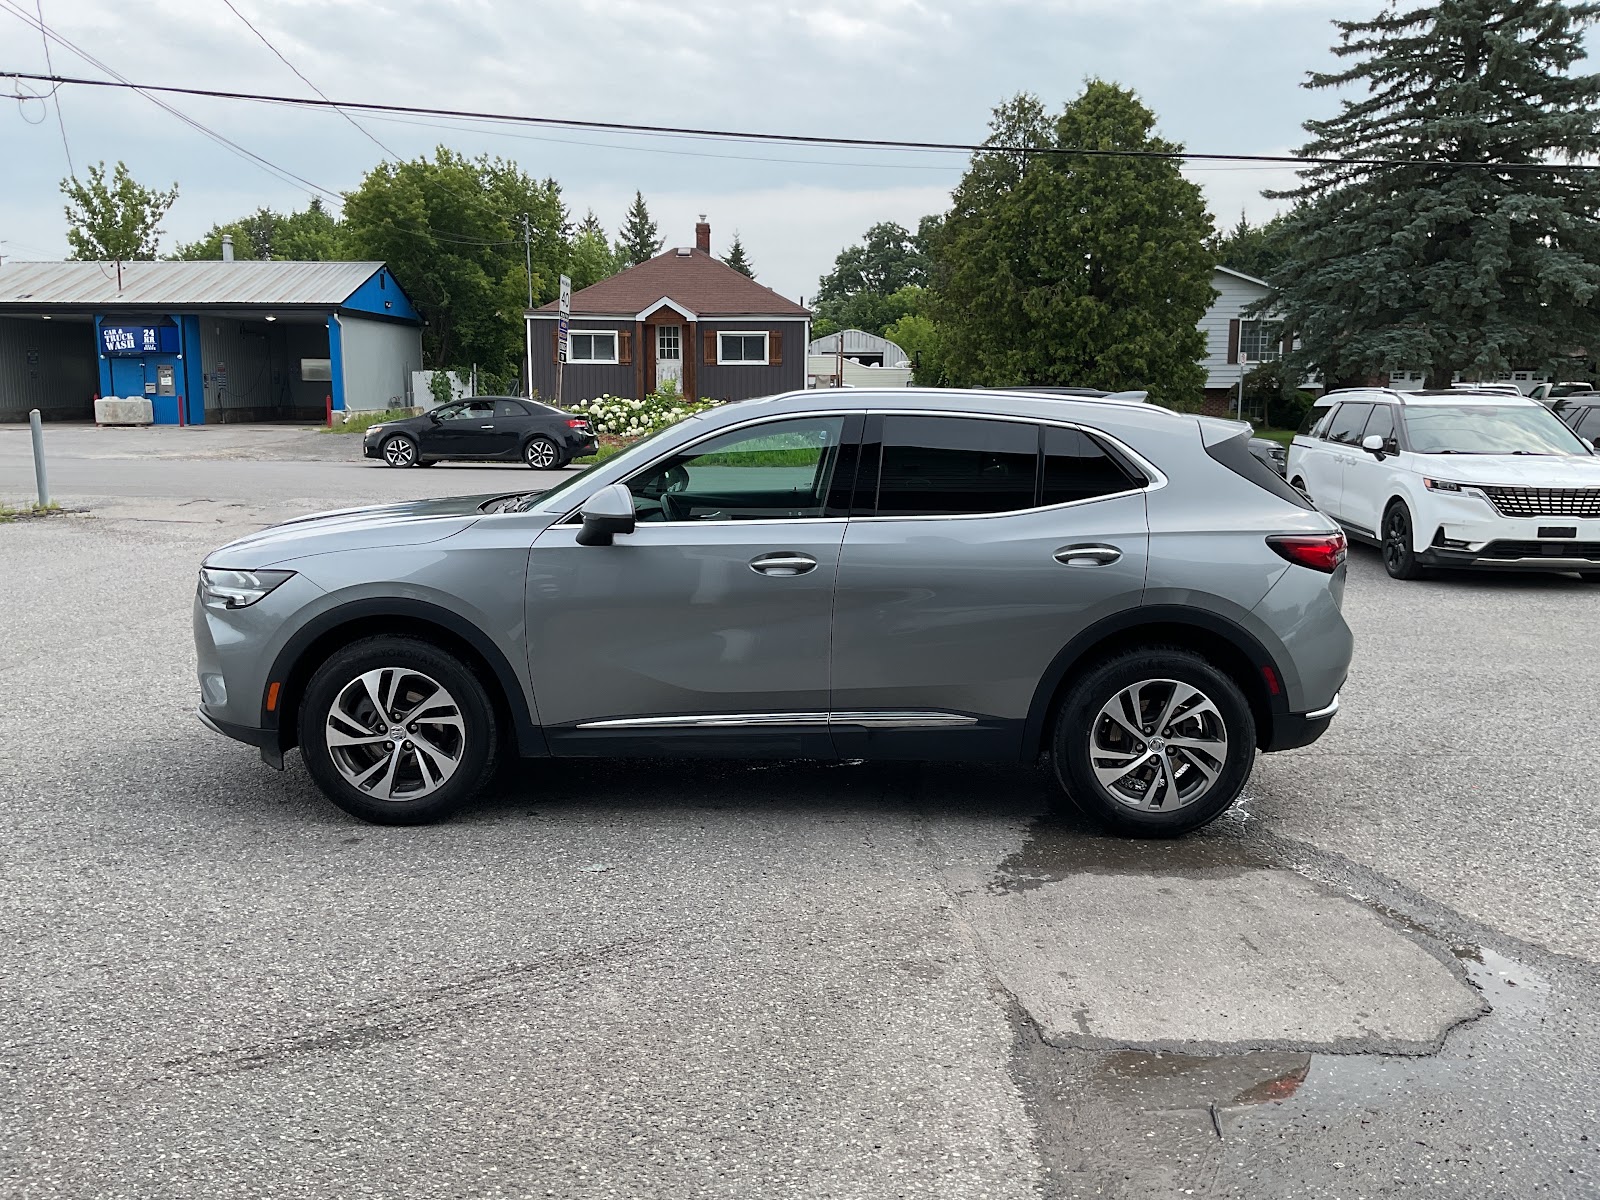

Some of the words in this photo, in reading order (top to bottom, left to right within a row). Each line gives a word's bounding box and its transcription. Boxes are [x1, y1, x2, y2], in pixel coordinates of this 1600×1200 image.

[561, 291, 569, 308] 40
[104, 333, 134, 342] TRUCK
[106, 340, 135, 351] WASH
[380, 648, 437, 667] YOKOHA
